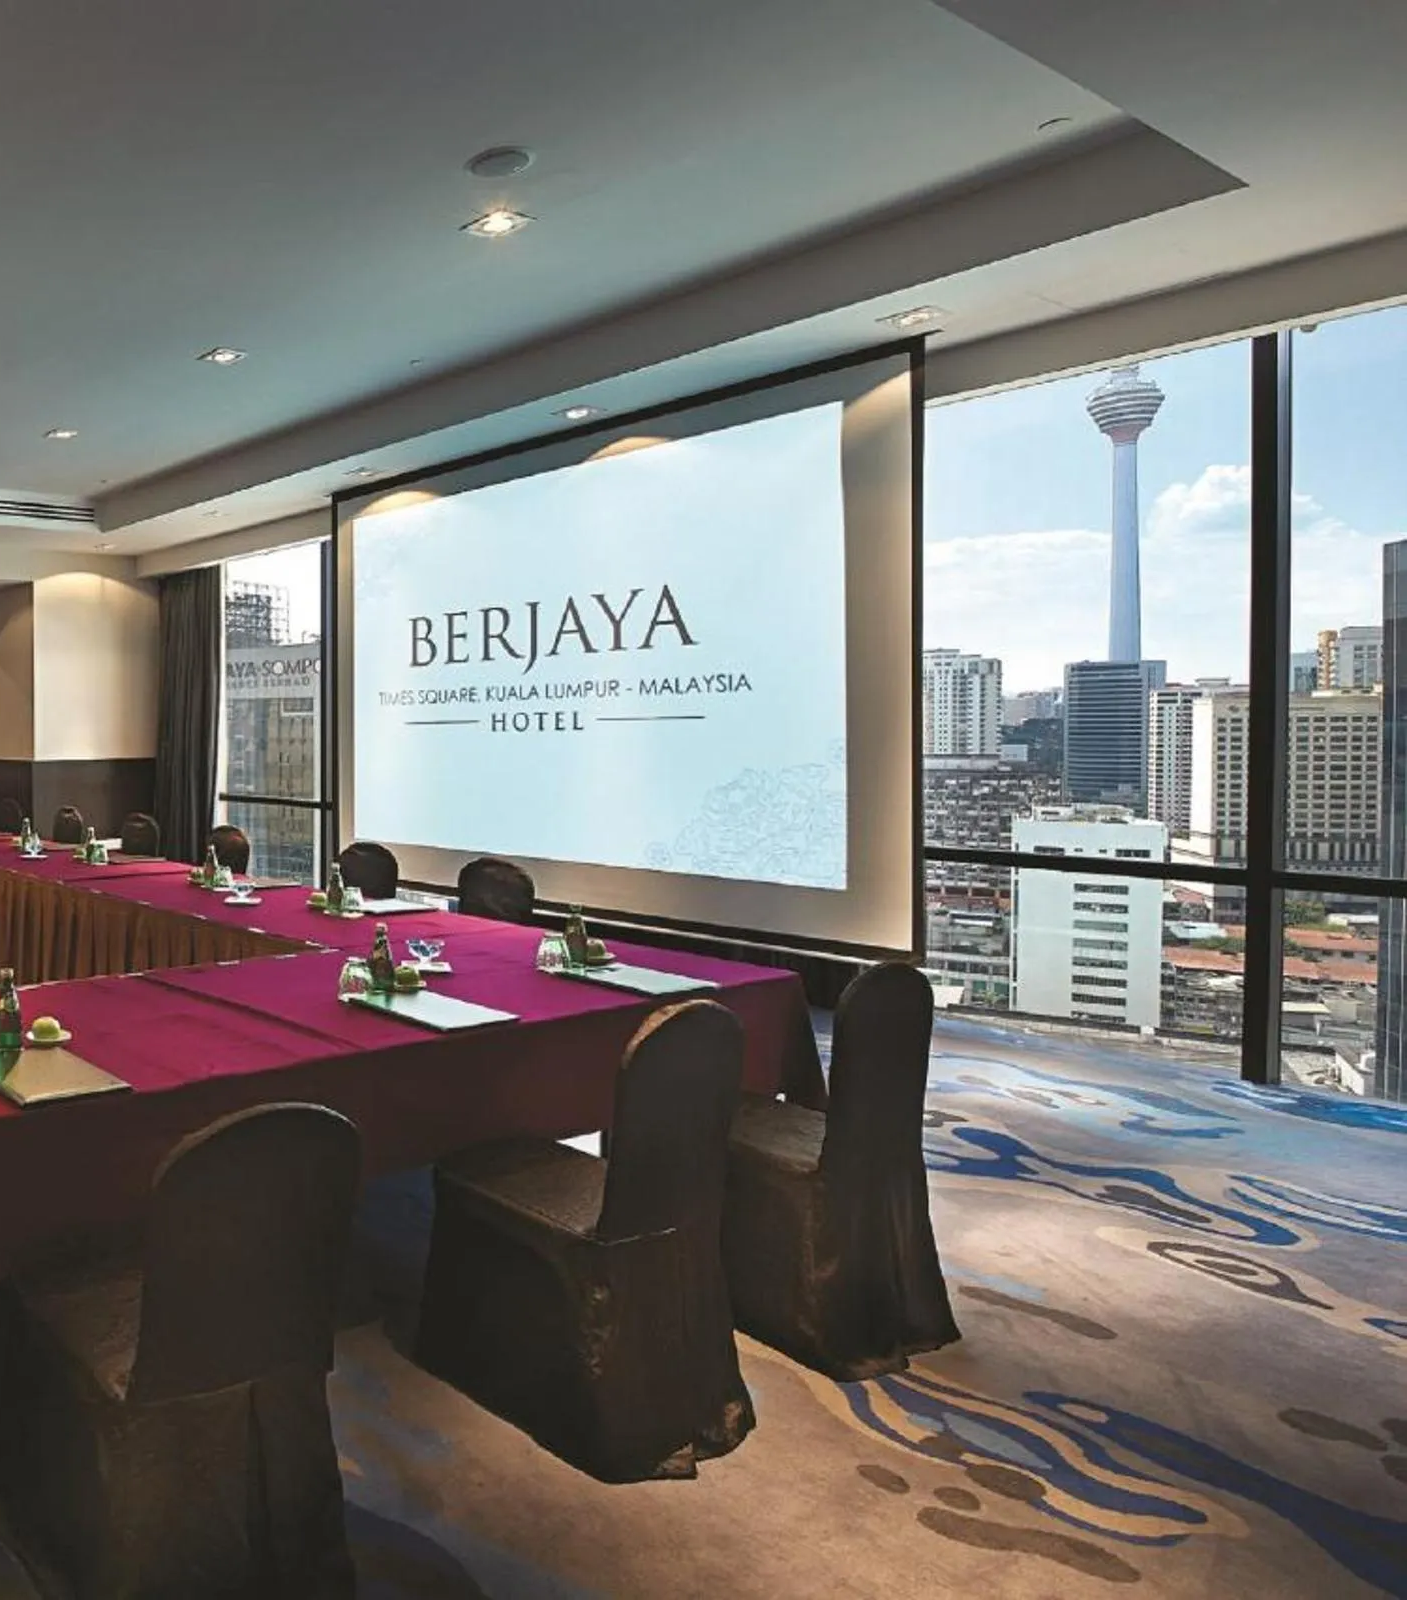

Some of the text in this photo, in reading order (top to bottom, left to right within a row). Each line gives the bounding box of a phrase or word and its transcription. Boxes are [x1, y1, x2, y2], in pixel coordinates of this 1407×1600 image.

[409, 584, 700, 674] BERJAYA
[379, 692, 414, 706] TIMES
[486, 683, 539, 703] KUALA
[545, 680, 620, 699] LUMPUR
[639, 674, 752, 695] MALAYSIA
[491, 711, 584, 732] HOTEL
